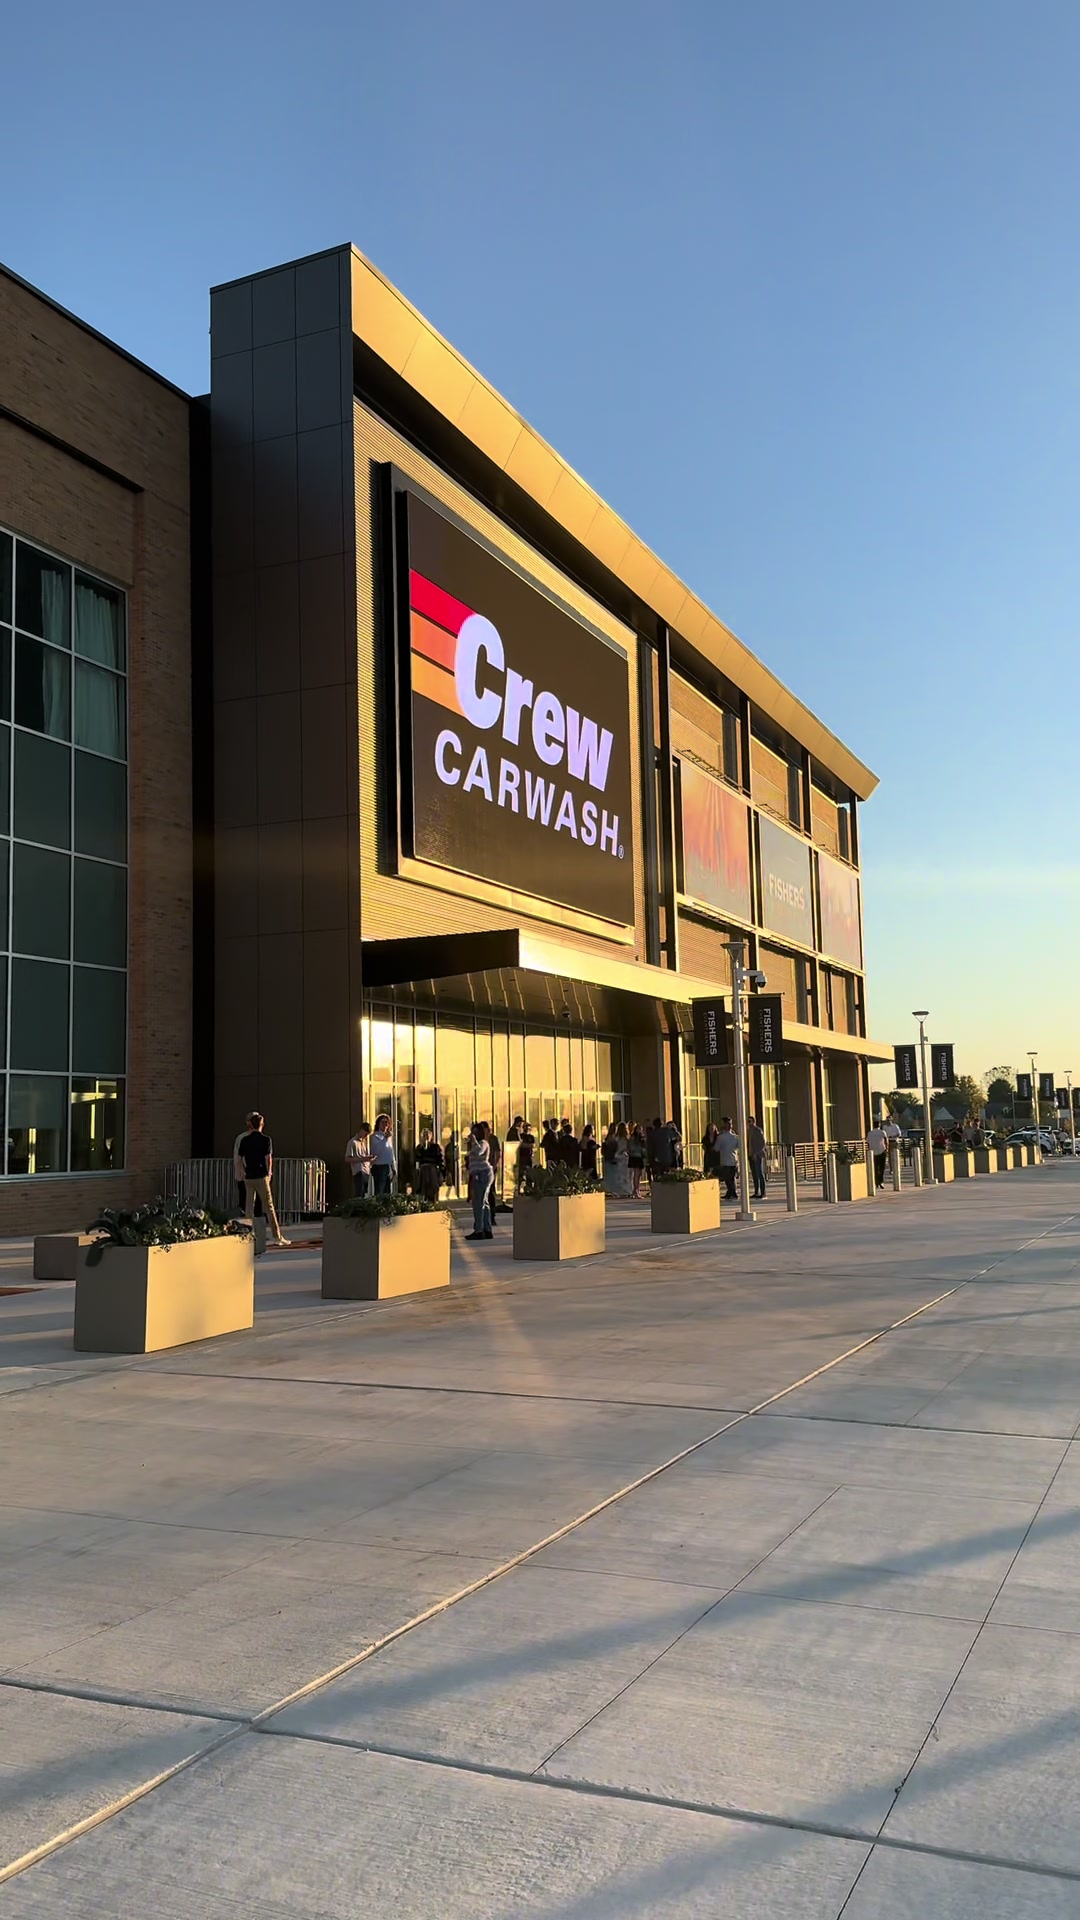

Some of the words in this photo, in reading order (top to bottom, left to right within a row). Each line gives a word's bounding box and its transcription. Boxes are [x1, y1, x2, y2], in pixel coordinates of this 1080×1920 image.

[455, 613, 613, 792] Crew
[769, 873, 805, 909] FISHERS
[708, 1010, 718, 1056] FISHERS
[764, 1008, 773, 1053] FISHERS
